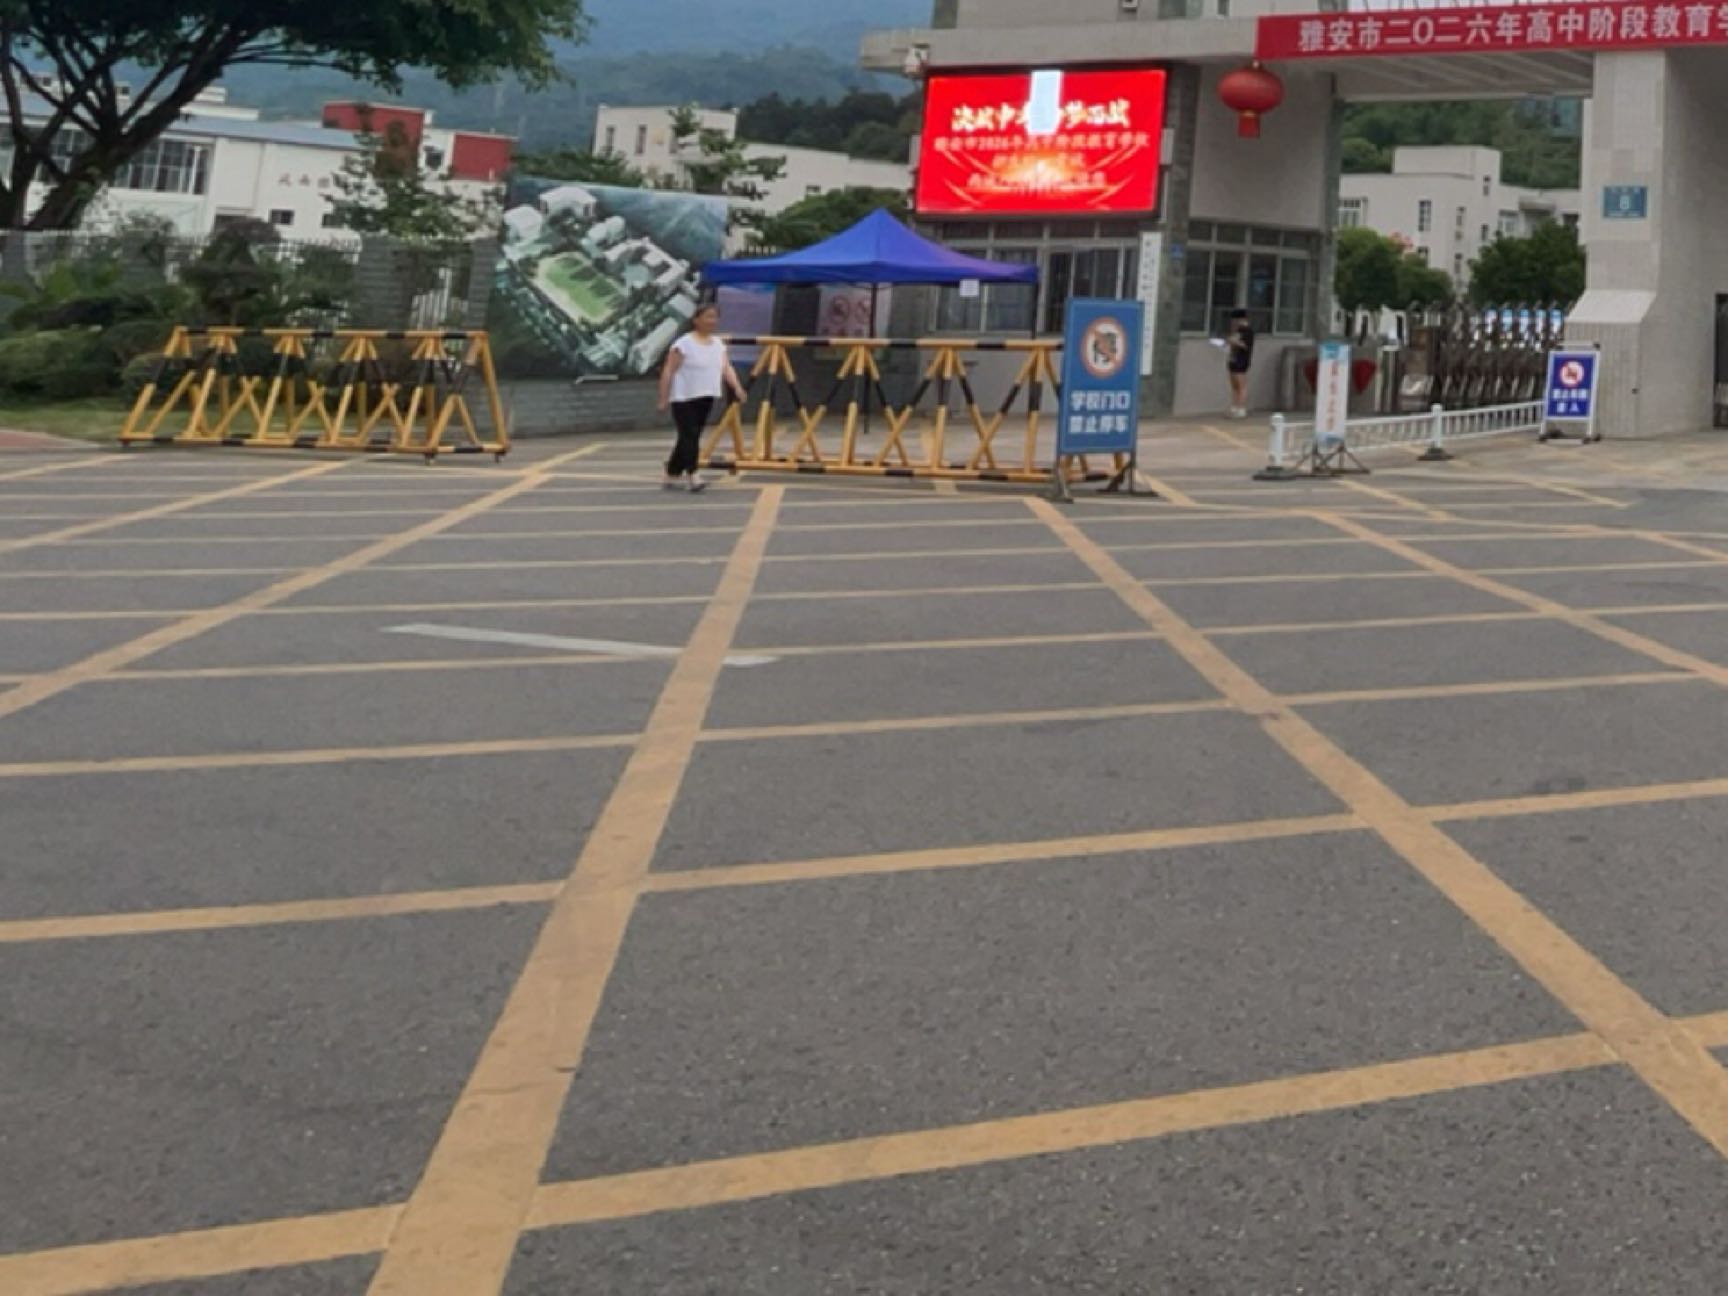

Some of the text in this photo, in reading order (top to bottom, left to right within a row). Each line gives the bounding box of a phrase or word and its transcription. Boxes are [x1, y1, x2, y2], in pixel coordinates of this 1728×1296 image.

[1070, 390, 1131, 412] 学校门口
[1069, 415, 1129, 435] 禁止停车
